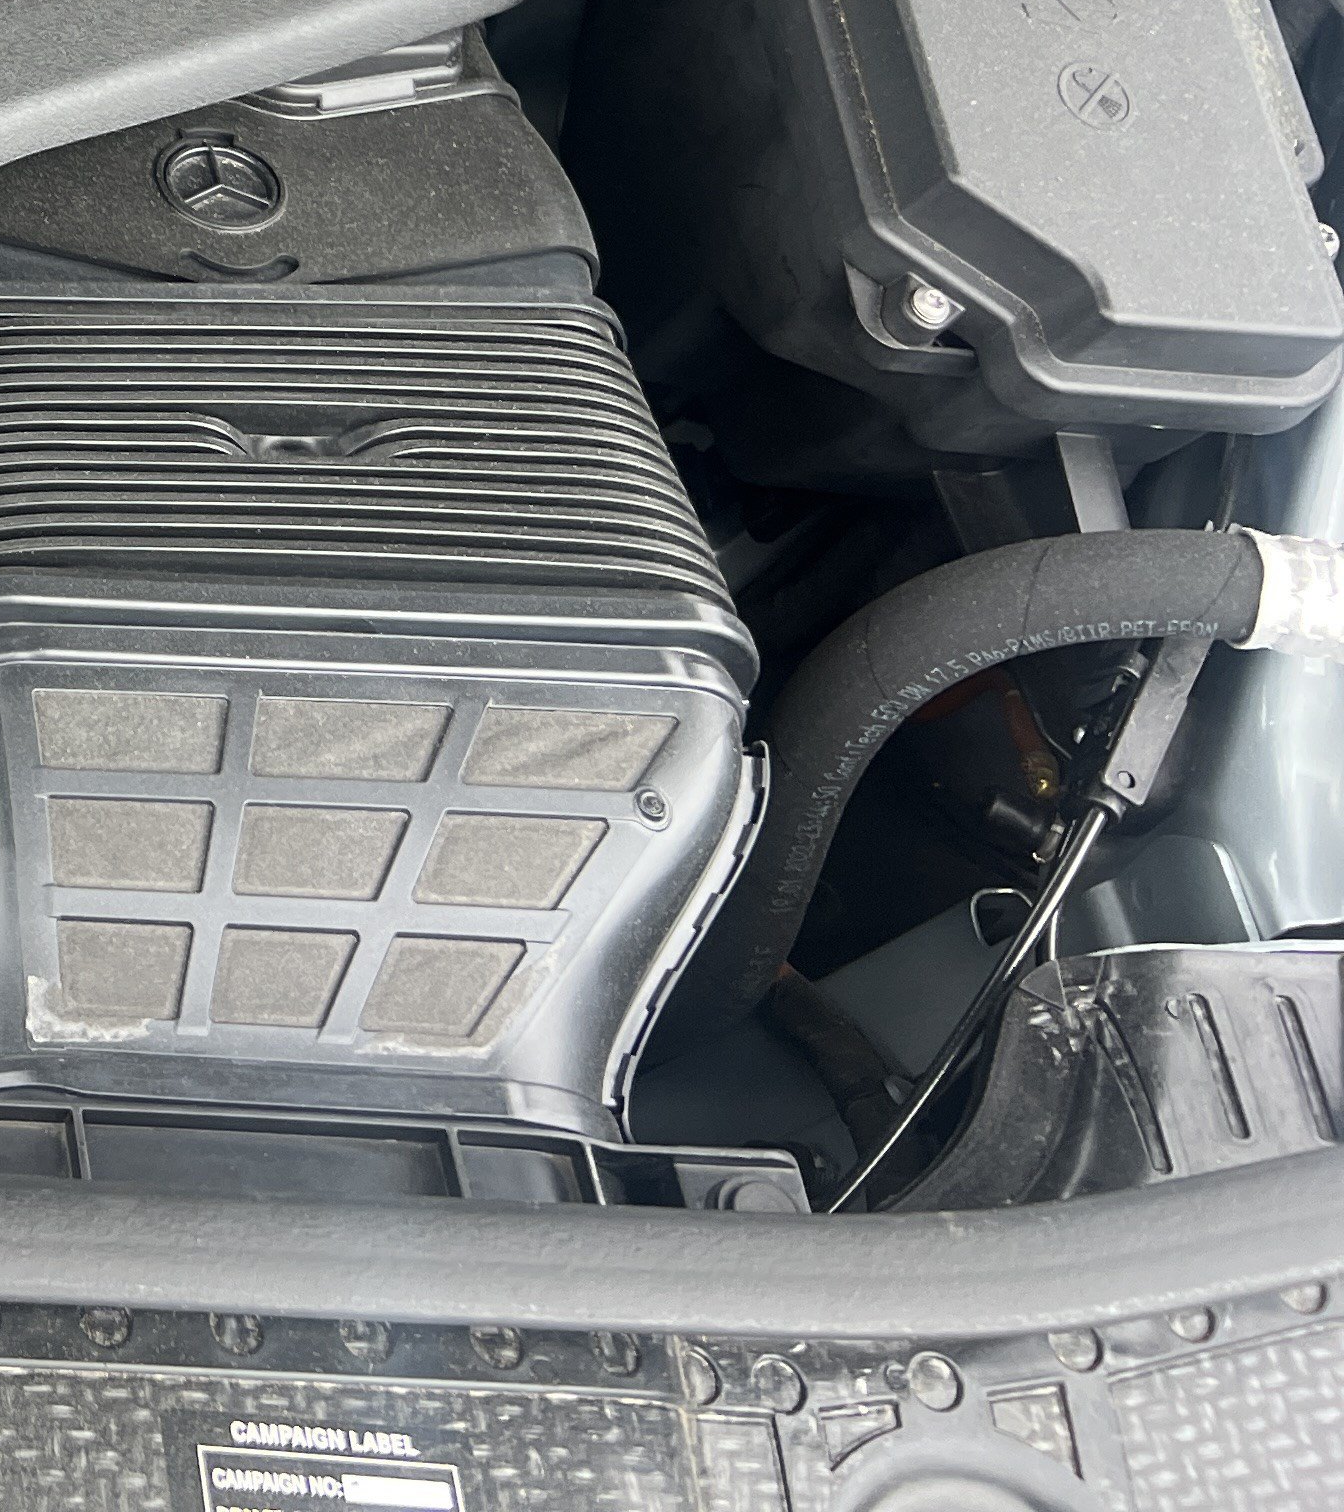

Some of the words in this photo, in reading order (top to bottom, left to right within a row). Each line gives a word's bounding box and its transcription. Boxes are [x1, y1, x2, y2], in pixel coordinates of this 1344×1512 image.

[229, 1420, 348, 1451] CAMPAIGN
[348, 1430, 421, 1457] LABEL
[211, 1467, 309, 1496] CAMPAIGN
